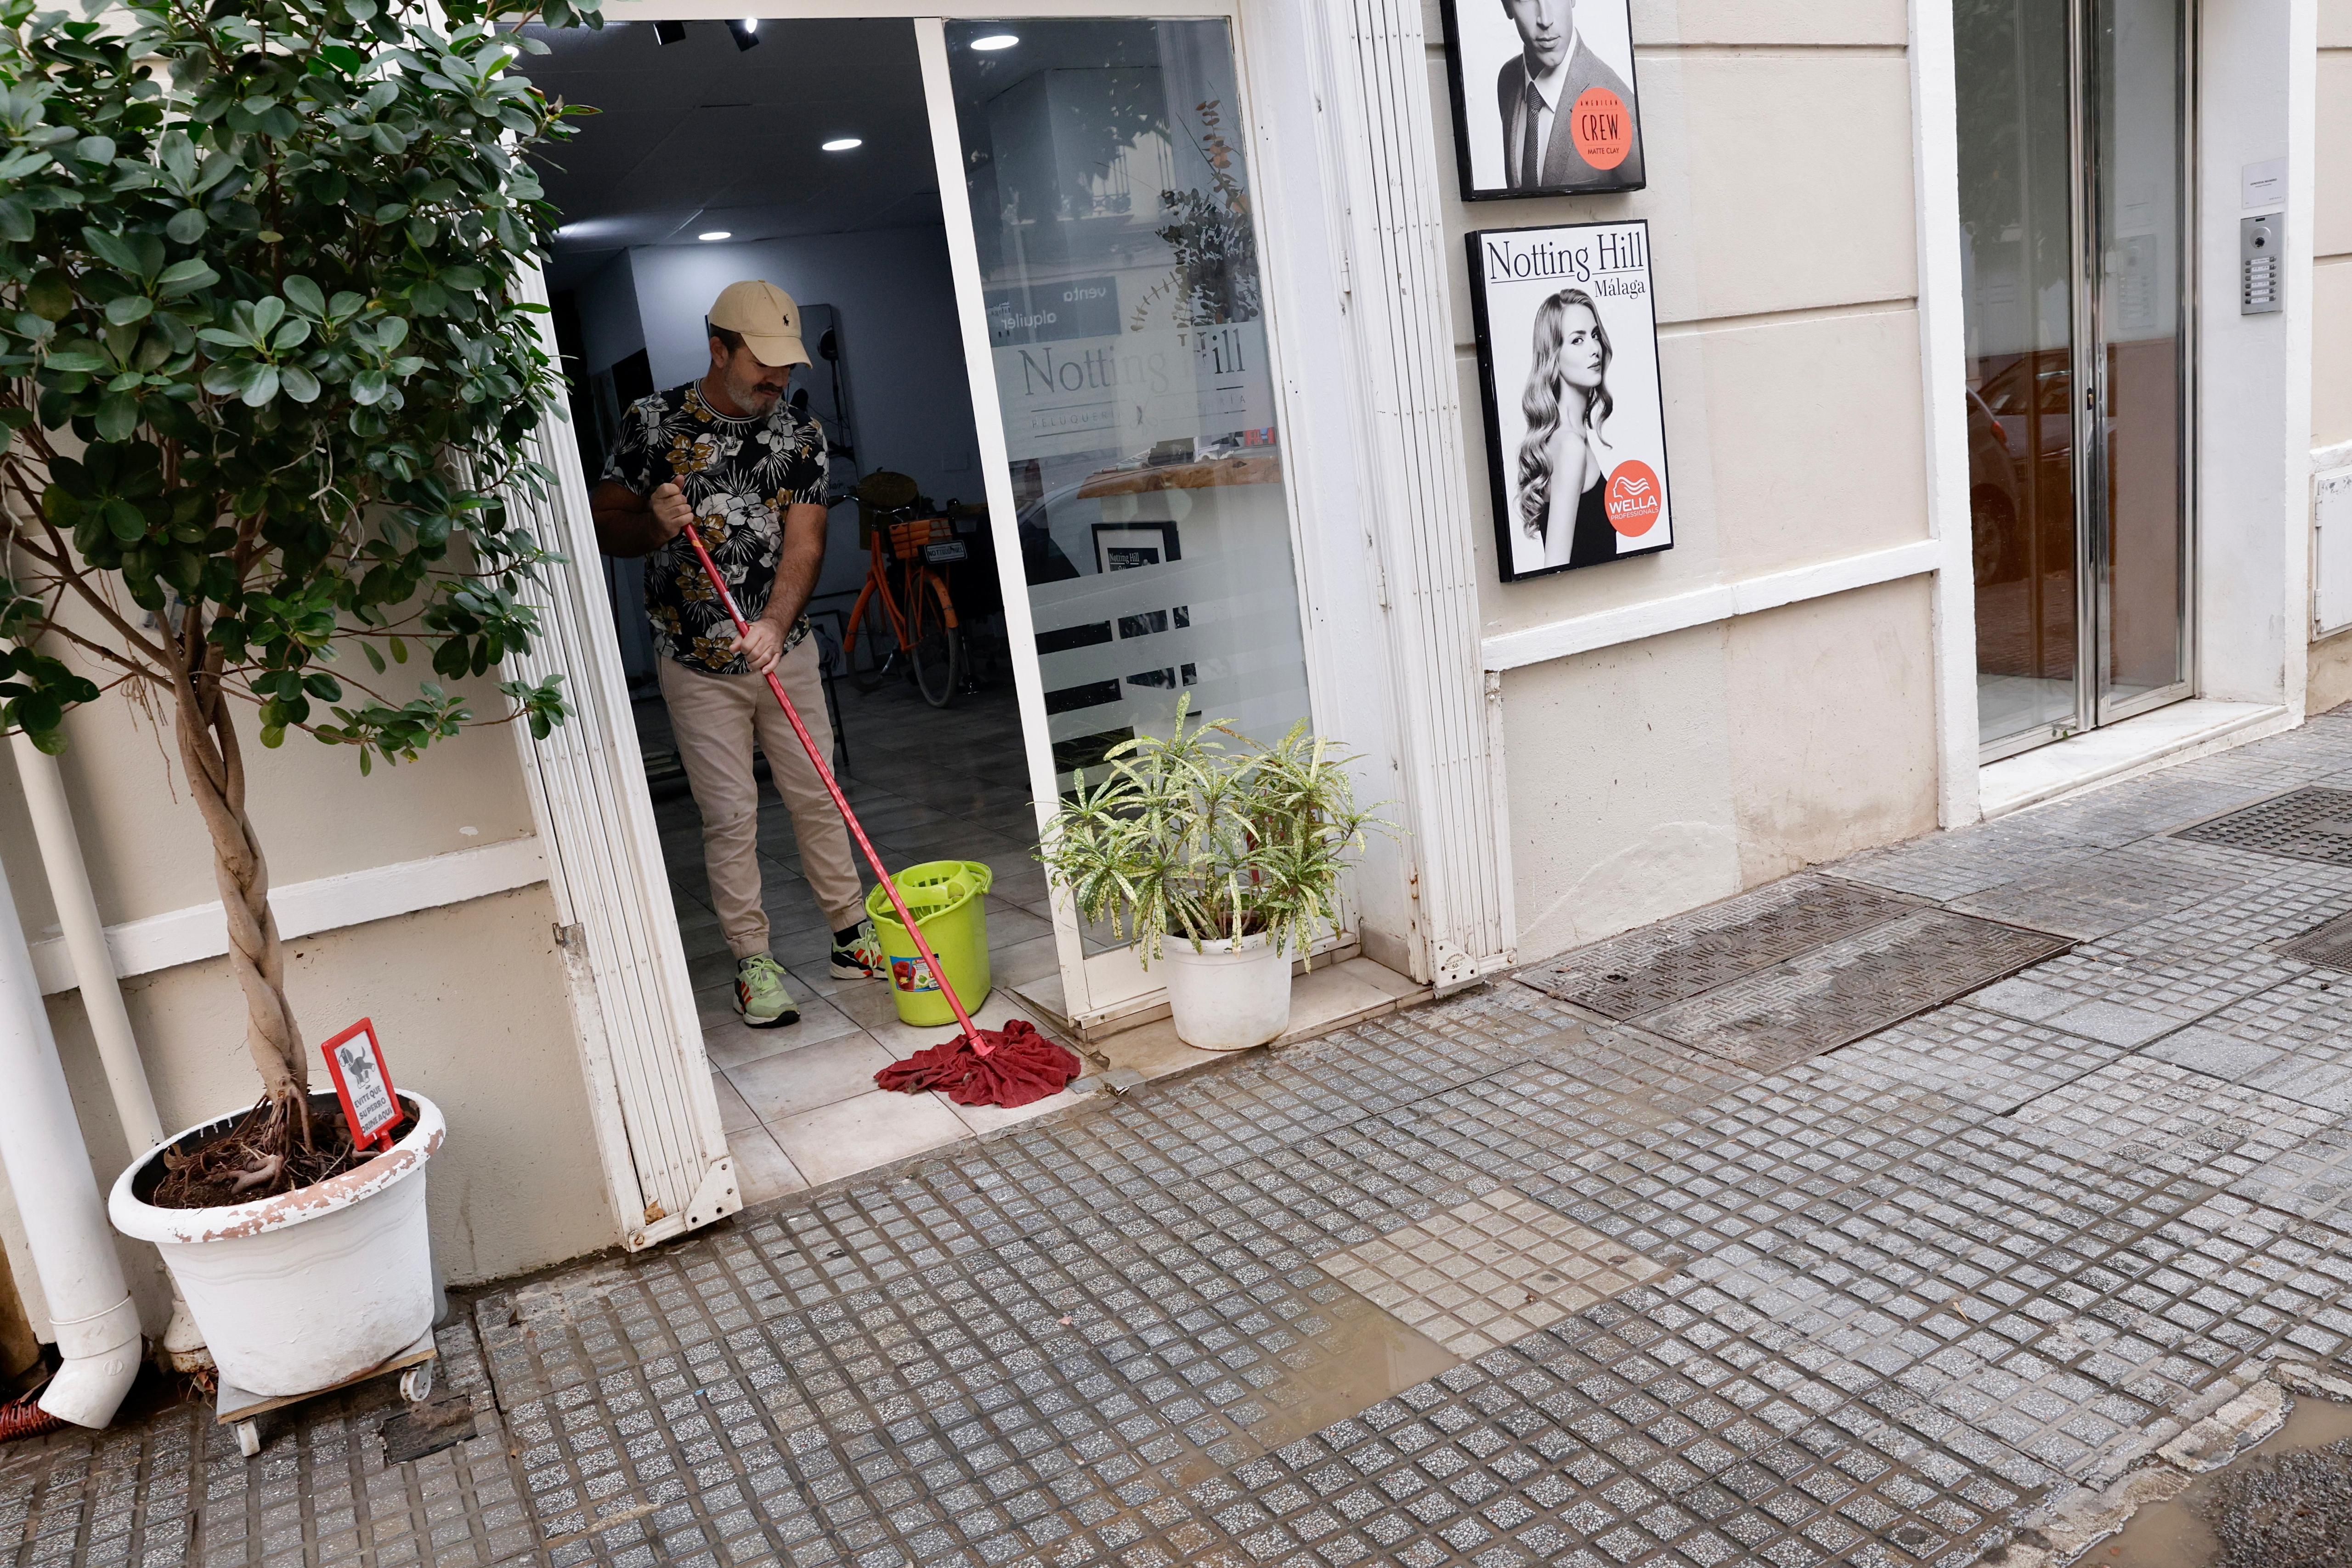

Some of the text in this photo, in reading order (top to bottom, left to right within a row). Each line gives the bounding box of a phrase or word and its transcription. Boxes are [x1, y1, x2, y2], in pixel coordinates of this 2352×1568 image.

[1582, 114, 1618, 141] CREW
[1487, 231, 1644, 283] Notting Hill
[1594, 277, 1646, 300] Málaga
[1018, 345, 1170, 396] Notting
[1609, 495, 1658, 514] WELLA
[1611, 507, 1659, 521] PROFESSIONALS
[1109, 552, 1140, 564] Notting Hill
[354, 1085, 382, 1108] EVITE QUE
[359, 1097, 386, 1120] SU PERRO
[362, 1116, 379, 1133] ORINE
